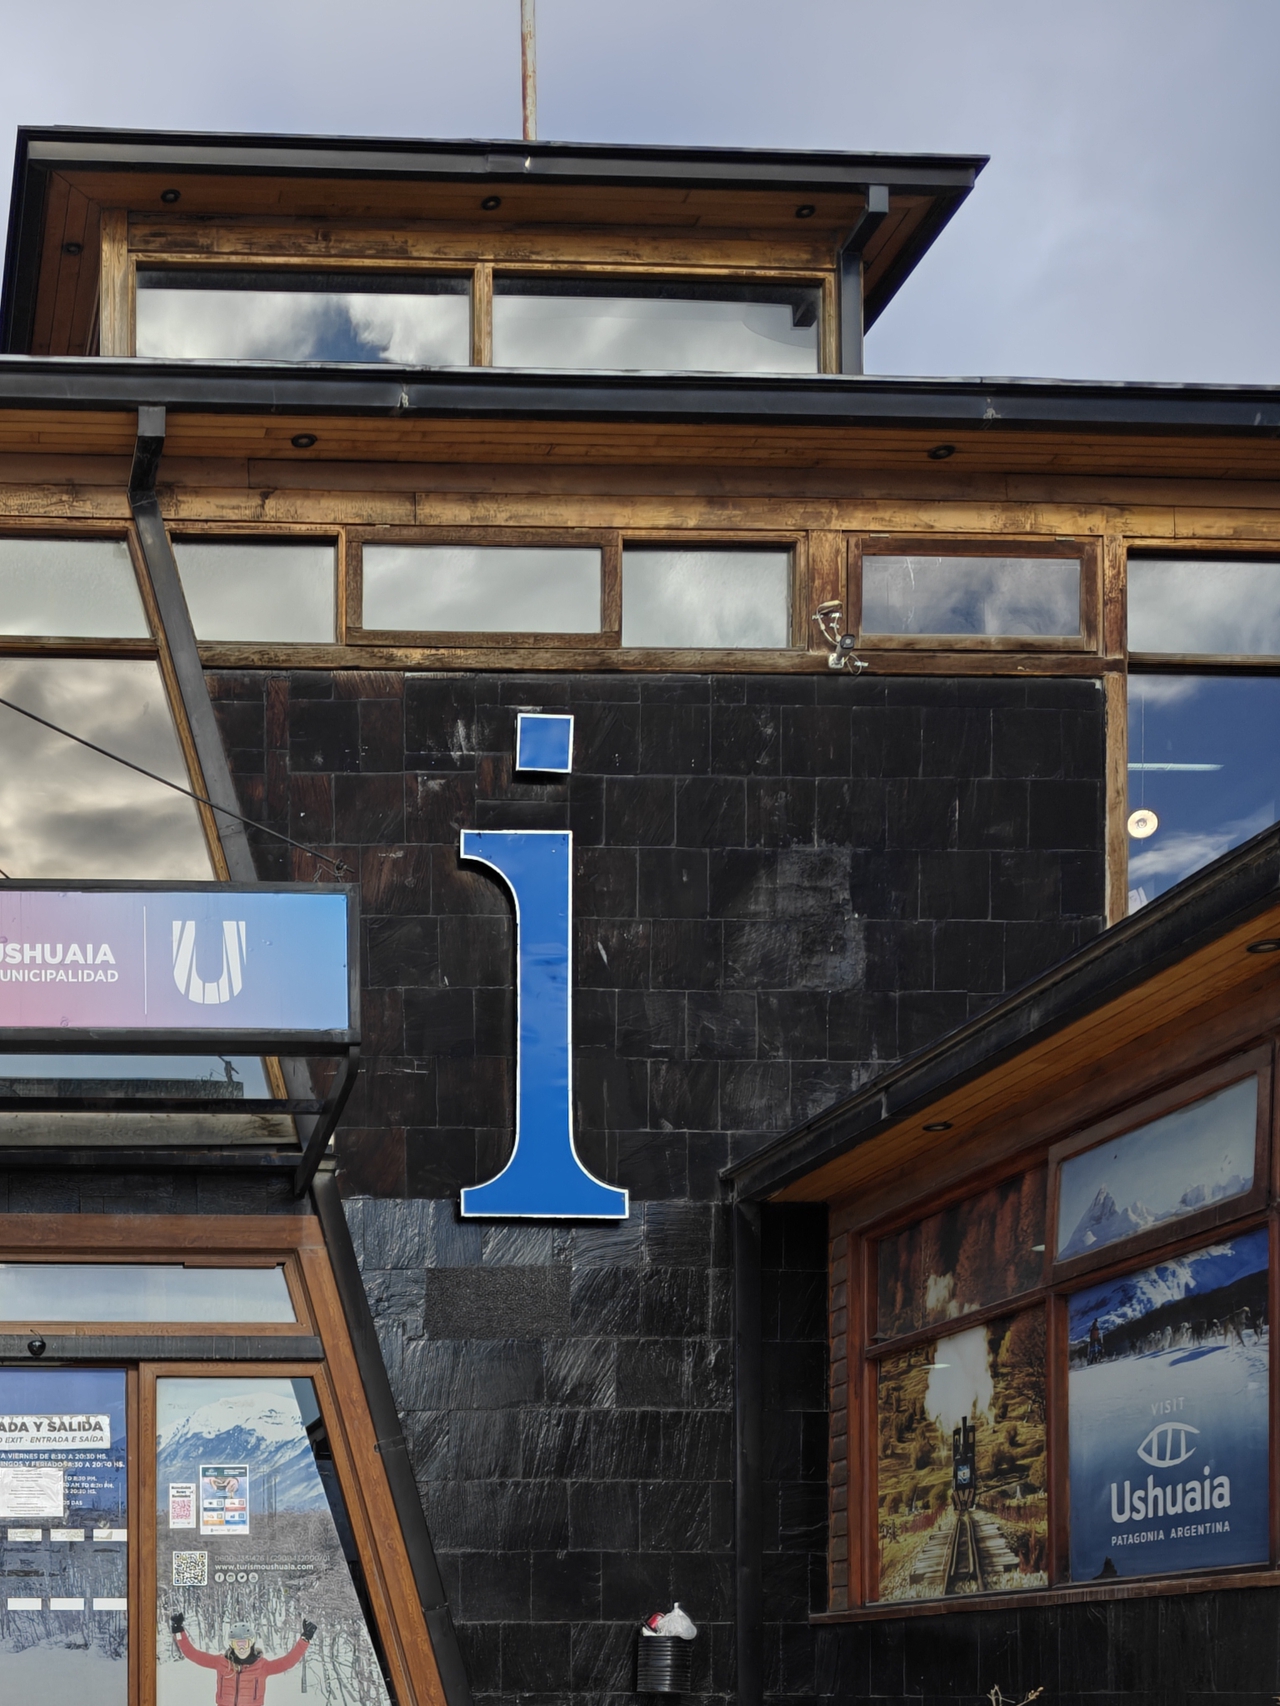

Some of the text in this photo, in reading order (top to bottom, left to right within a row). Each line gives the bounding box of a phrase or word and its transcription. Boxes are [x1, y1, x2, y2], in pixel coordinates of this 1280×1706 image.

[1150, 1396, 1185, 1416] VISIT
[34, 1421, 46, 1433] Y
[47, 1420, 104, 1433] SALIDA
[5, 1436, 24, 1444] EXIT
[30, 1436, 69, 1444] ENTRADA
[79, 1435, 104, 1443] SAÍDA
[1110, 1465, 1231, 1524] Ushuaia
[1111, 1520, 1231, 1547] PATAGONIA ARGENTINA
[214, 1562, 314, 1571] www.turismoushuaia.com
